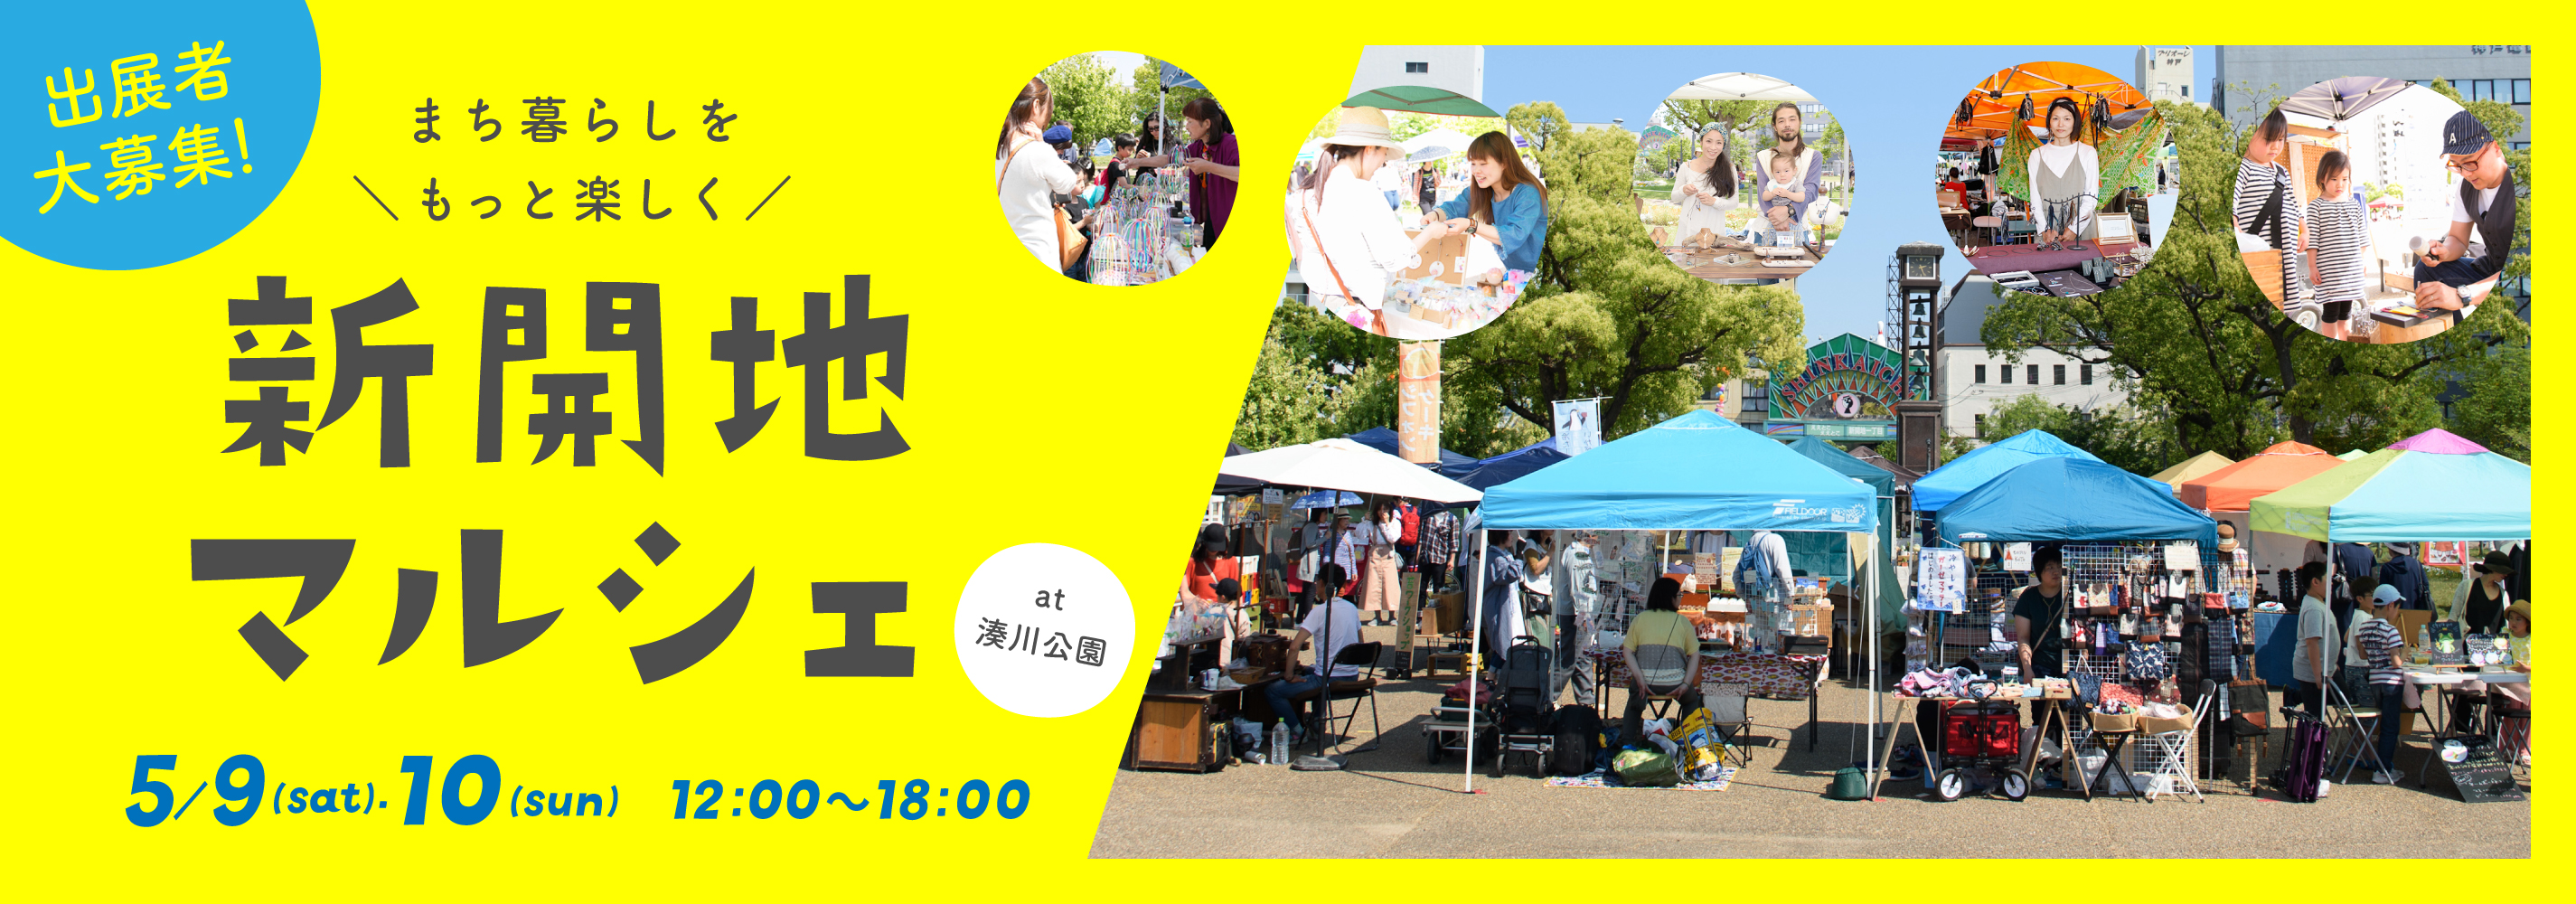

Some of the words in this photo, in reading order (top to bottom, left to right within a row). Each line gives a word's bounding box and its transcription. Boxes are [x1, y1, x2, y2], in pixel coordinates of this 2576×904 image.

[2449, 132, 2457, 145] A
[1848, 427, 1884, 436] 新開地一丁目
[1948, 553, 1957, 582] 冷やし
[1937, 556, 1946, 607] ガーゼマフラー
